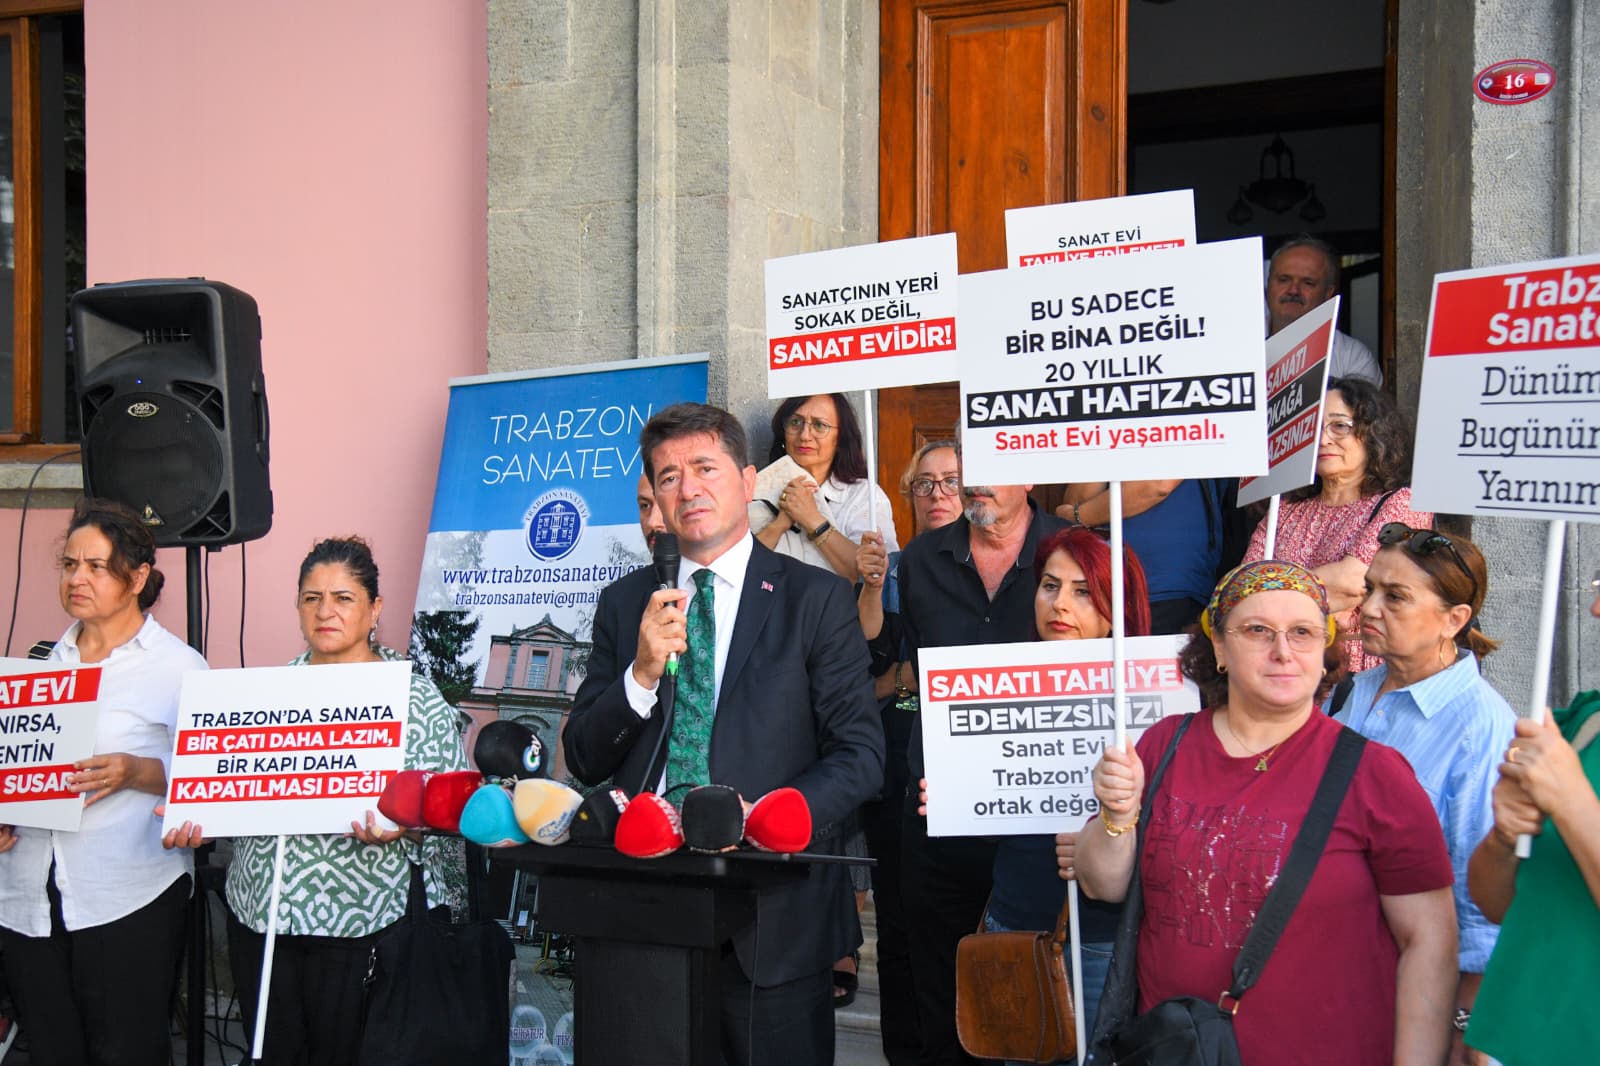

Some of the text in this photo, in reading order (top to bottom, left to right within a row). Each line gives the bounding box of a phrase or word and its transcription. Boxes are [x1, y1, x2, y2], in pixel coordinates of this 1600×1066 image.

[1505, 74, 1525, 89] 16
[1058, 226, 1141, 248] SANAT EVİ
[782, 272, 939, 309] SANATÇININ YERİ
[1031, 286, 1175, 321] BU SADECE
[1503, 269, 1600, 310] Trabz
[794, 300, 921, 330] SOKAK DEĞİL,
[773, 323, 953, 364] SANAT EVİDİR!
[1006, 314, 1205, 355] BİR BİNA DEĞİL!
[1045, 354, 1163, 383] 20 YILLIK
[970, 377, 1253, 422] SANAT HAFIZASI!
[490, 403, 652, 445] TRABZON
[995, 419, 1224, 450] Sanat Evi yaşamalı.
[31, 669, 77, 703] EVİ
[931, 671, 1040, 698] SANATI
[192, 705, 394, 728] TRABZON’DA SANATA
[186, 728, 393, 753] BİR ÇATI DAHA LAZIM,
[1002, 736, 1106, 758] Sanat Evi
[217, 754, 357, 774] BİR KAPI DAHA
[176, 777, 323, 800] KAPATILMASI
[974, 794, 1098, 816] ortak değe
